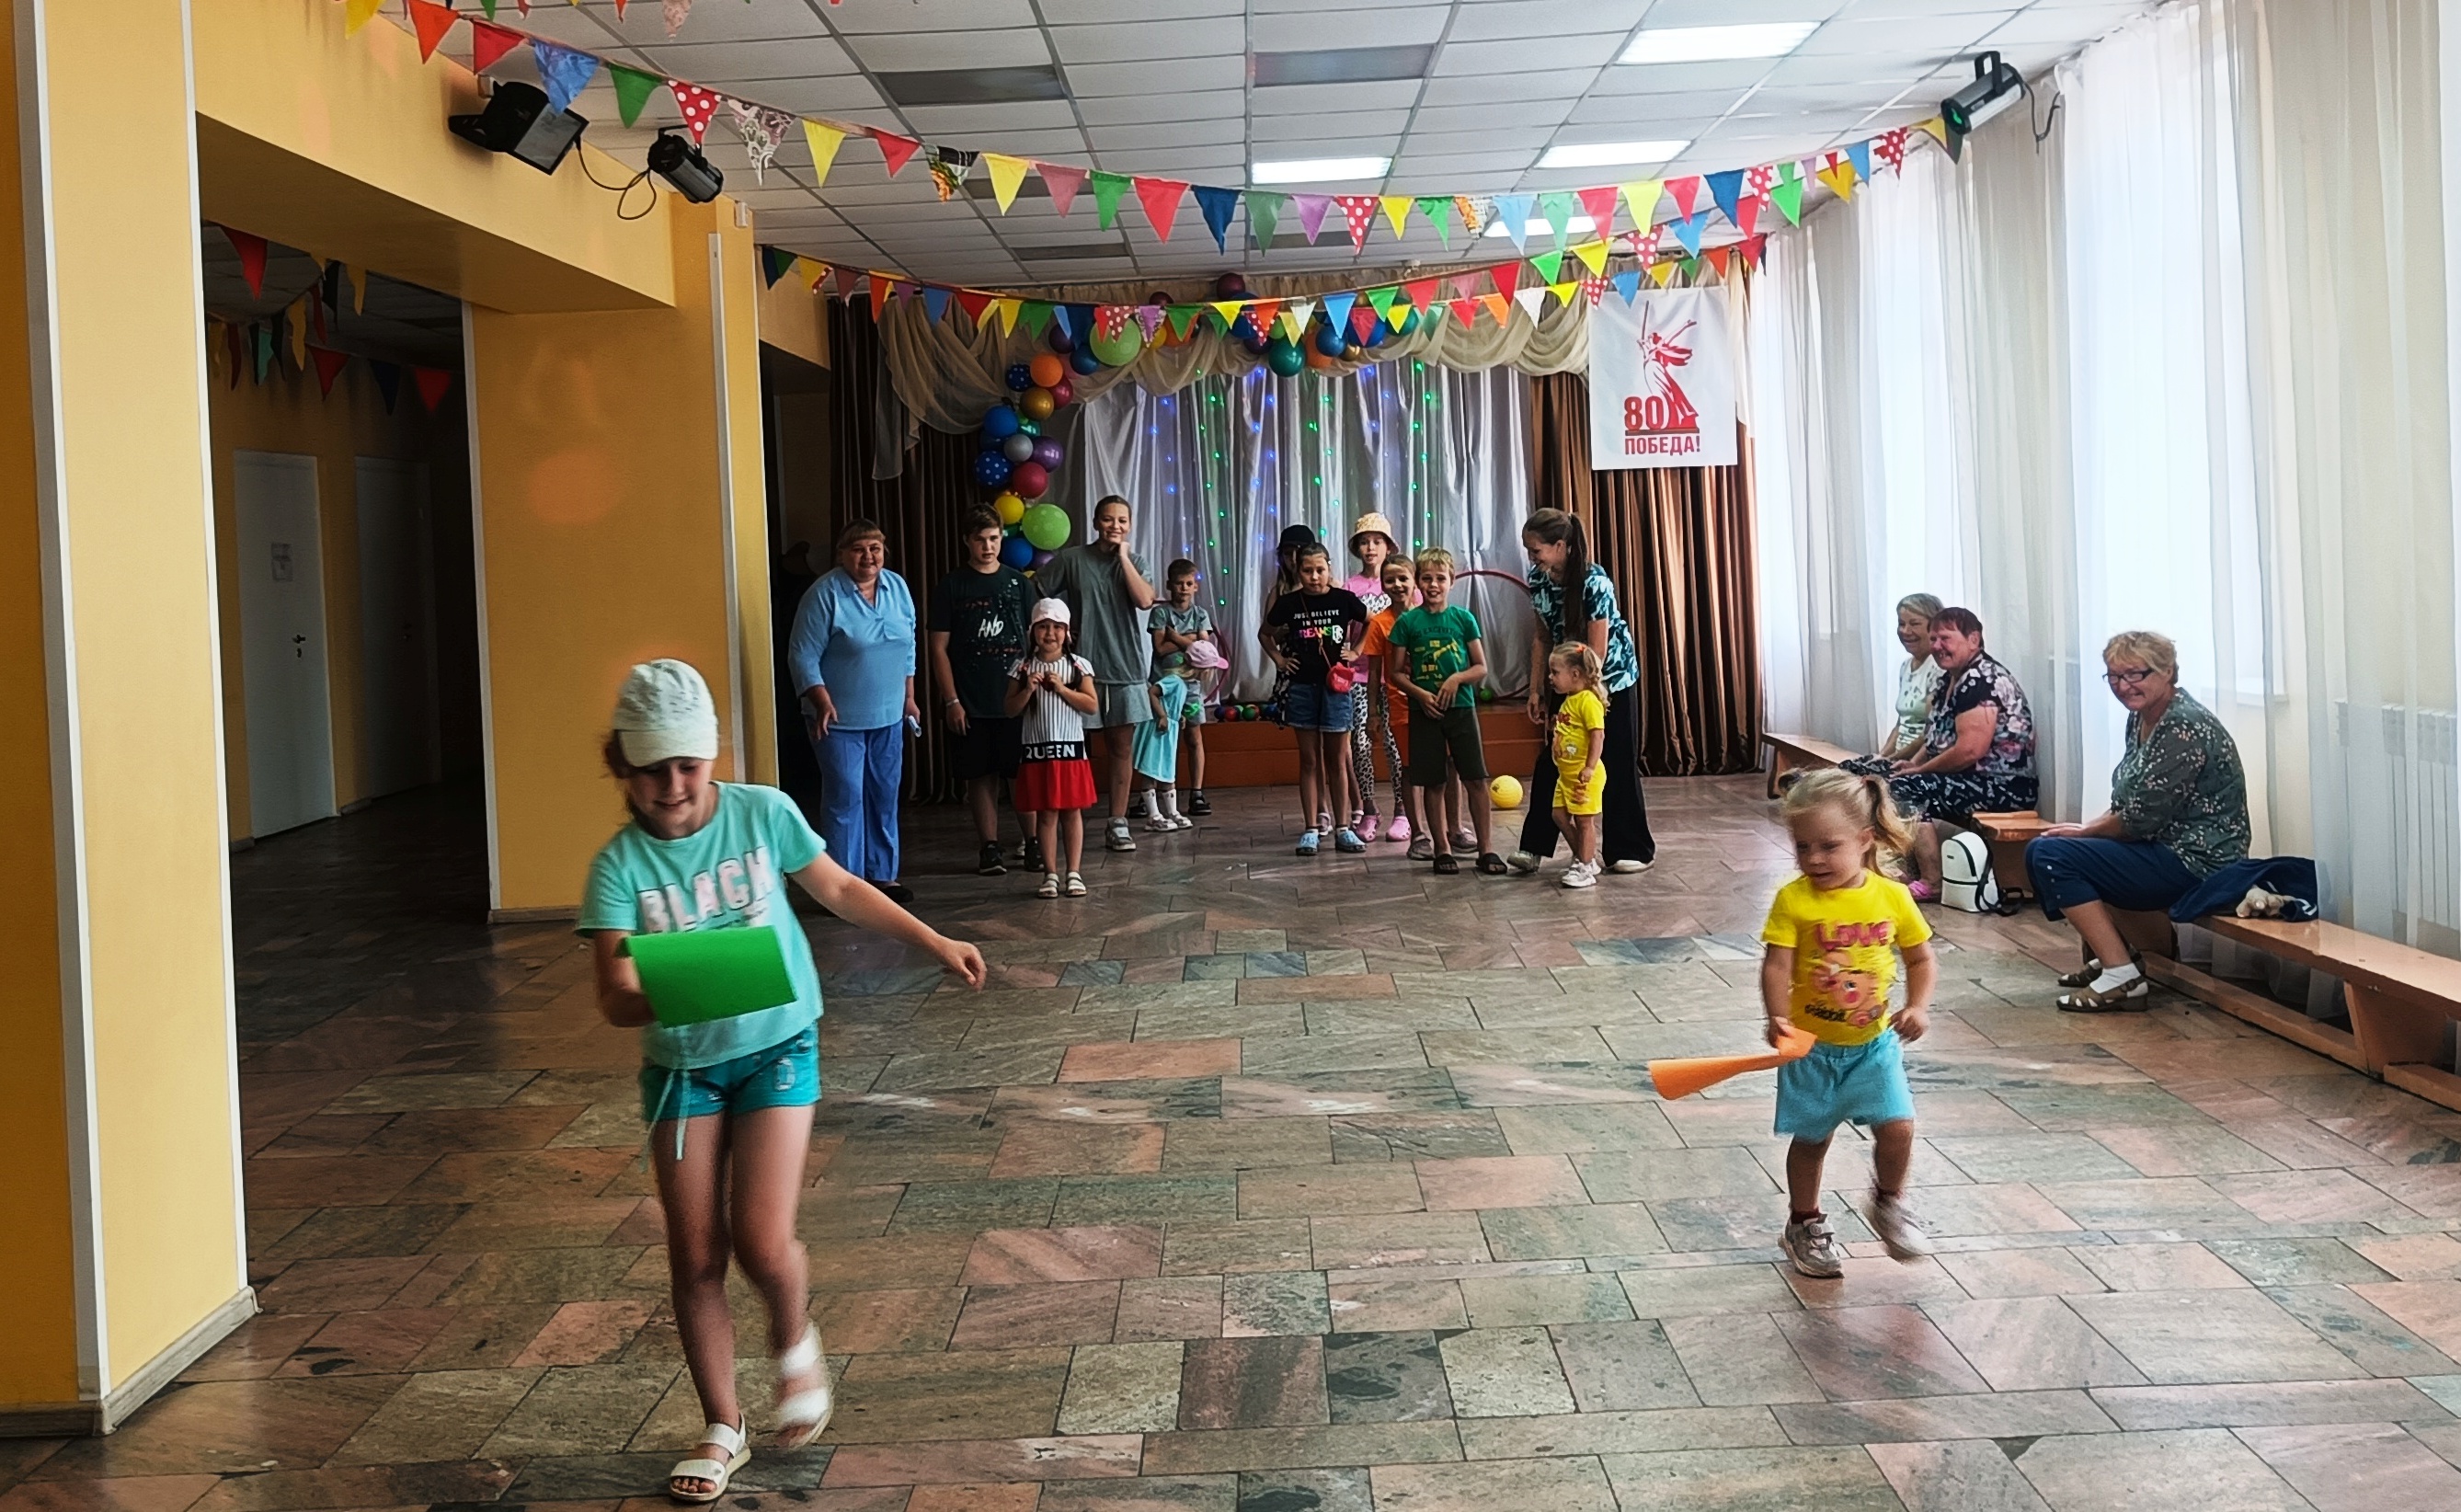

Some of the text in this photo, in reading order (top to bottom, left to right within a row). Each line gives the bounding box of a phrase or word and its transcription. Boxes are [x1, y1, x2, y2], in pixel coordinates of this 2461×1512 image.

[1624, 396, 1665, 430] 80
[1624, 436, 1700, 455] ПОБЕДА!
[1311, 609, 1339, 617] BELIEVE
[978, 614, 1004, 637] AND
[1815, 922, 1890, 951] LOVE
